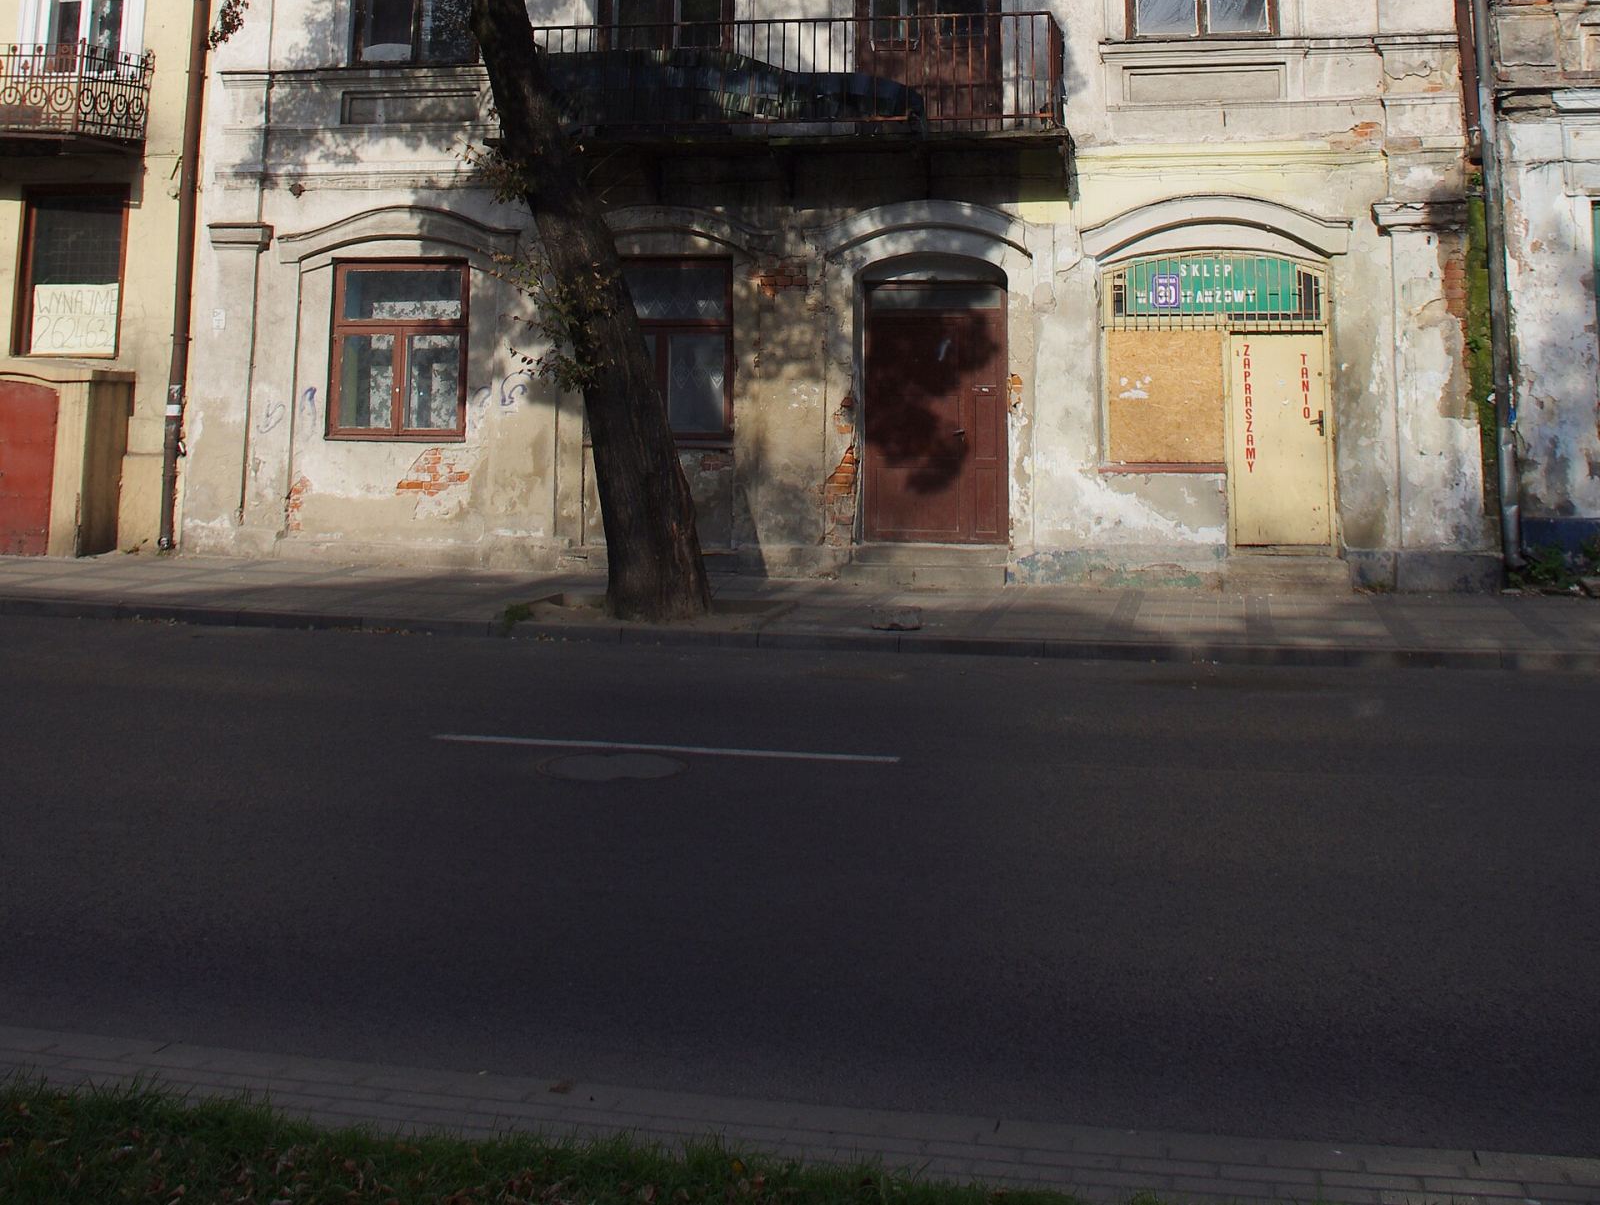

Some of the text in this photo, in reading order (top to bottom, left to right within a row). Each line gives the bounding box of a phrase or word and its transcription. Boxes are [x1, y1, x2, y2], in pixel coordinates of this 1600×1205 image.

[1180, 264, 1232, 277] SKLEP
[1243, 344, 1256, 473] ZAPRASZAMY
[1300, 353, 1311, 419] TANIO
